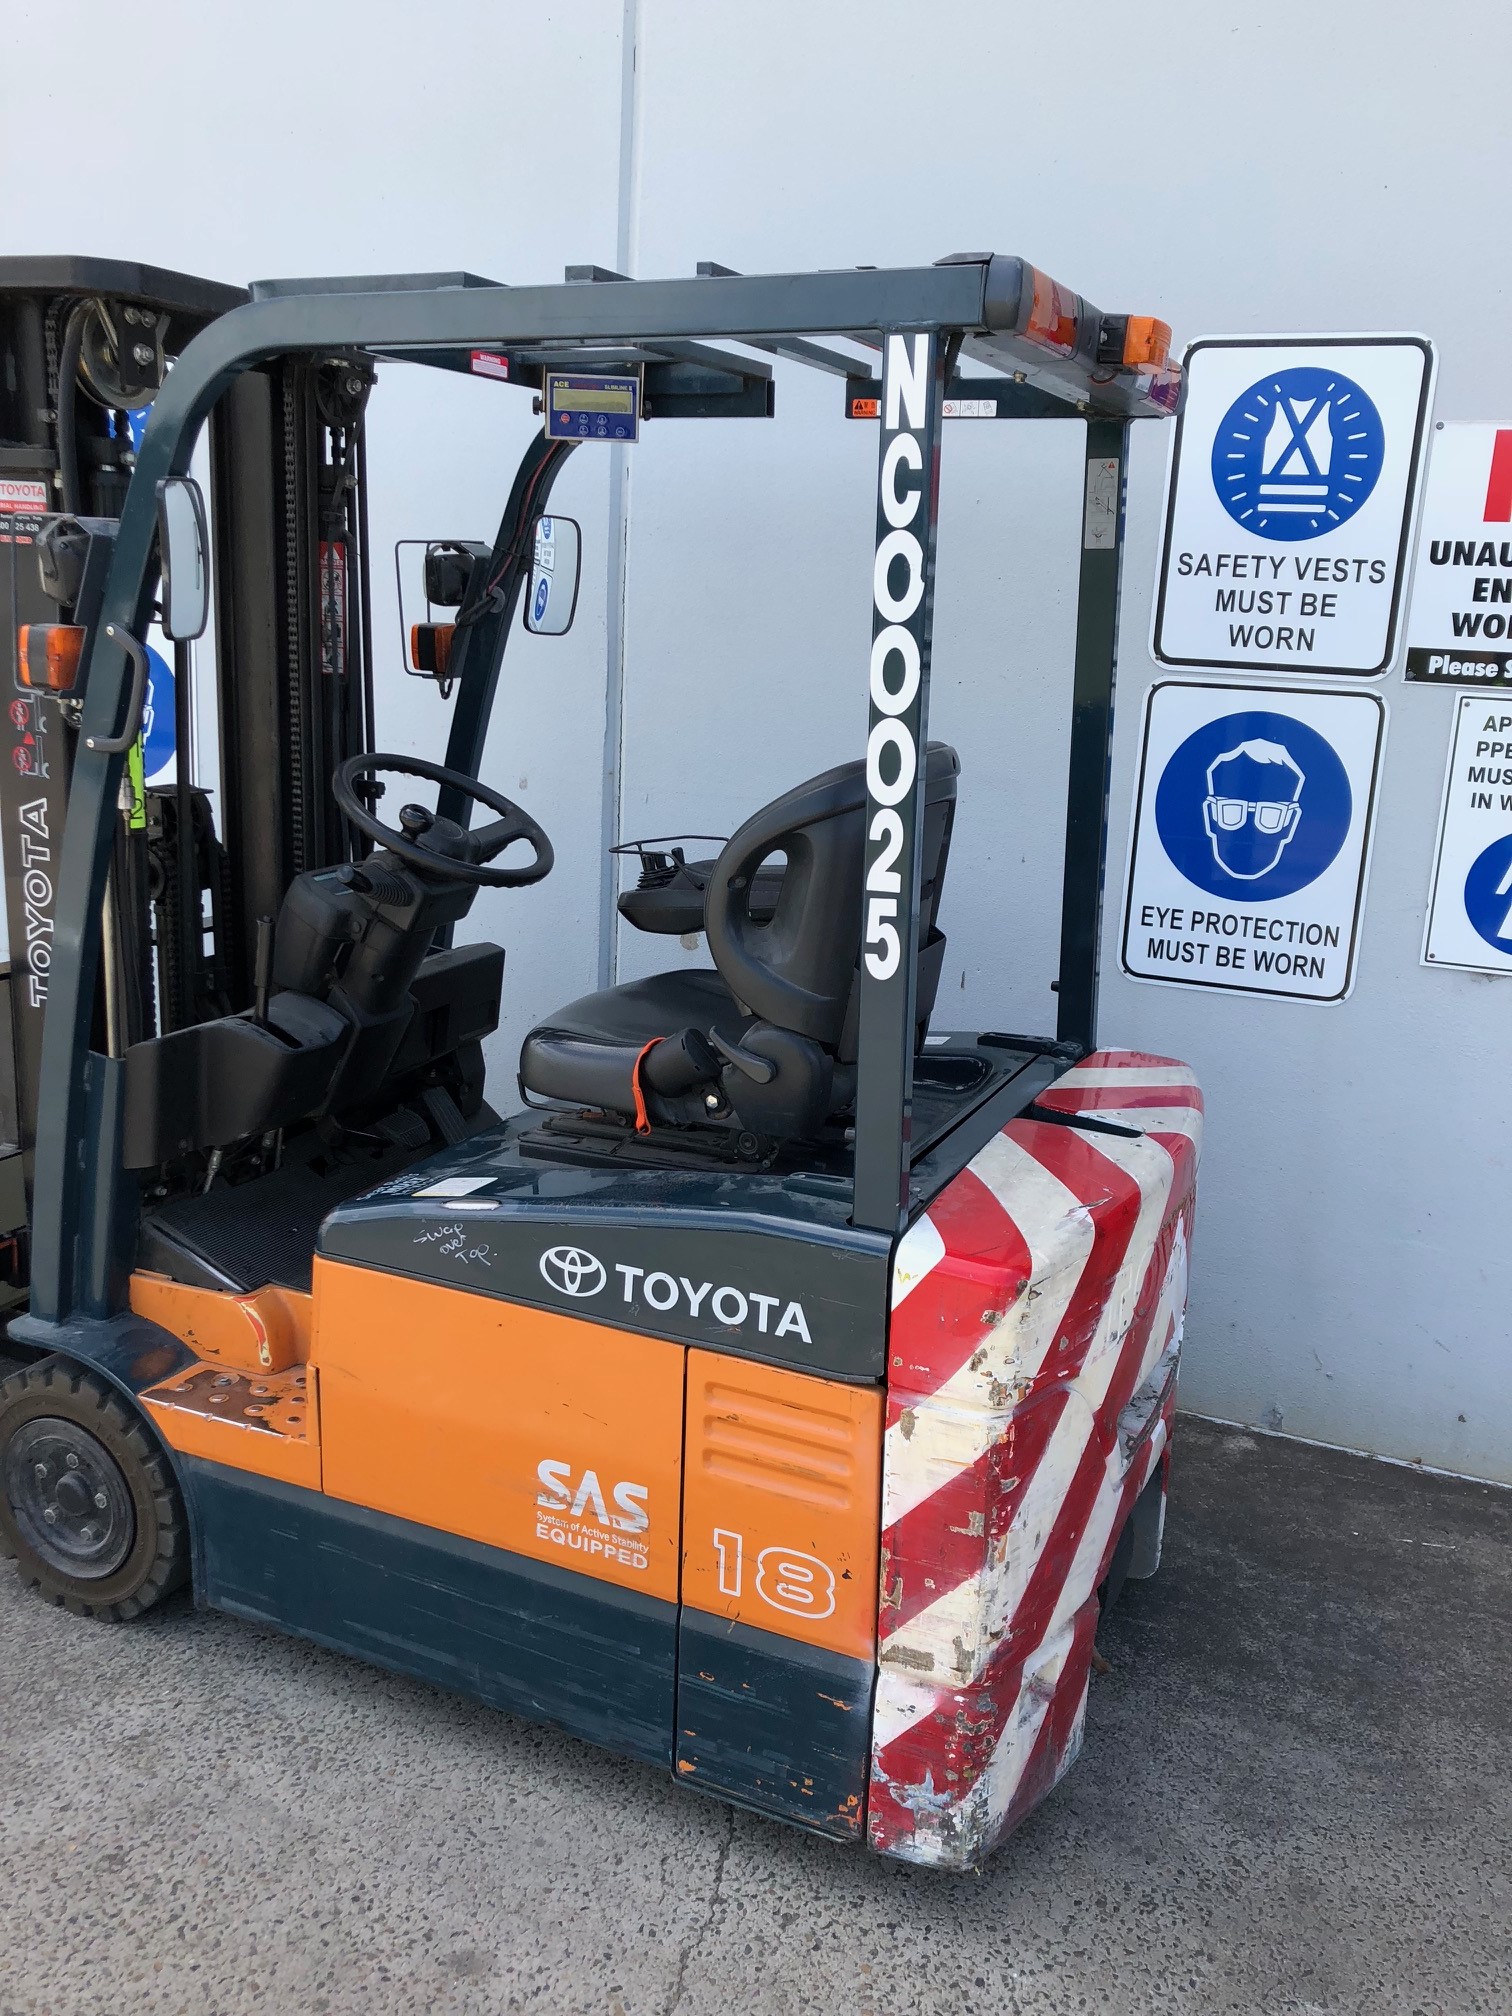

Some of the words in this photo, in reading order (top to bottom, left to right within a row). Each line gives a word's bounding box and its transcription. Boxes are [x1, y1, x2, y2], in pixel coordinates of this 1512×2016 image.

[0, 484, 45, 497] TOYOTA
[25, 523, 40, 532] 438
[1177, 552, 1286, 580] SAFETY
[1294, 556, 1387, 584] VESTS
[1215, 588, 1292, 615] MUST
[1299, 592, 1338, 617] BE
[1229, 624, 1315, 651] WORN
[1451, 612, 1512, 639] WO
[1428, 655, 1499, 678] Please
[1470, 792, 1493, 810] IN
[19, 797, 54, 1008] TOYOTA
[1140, 905, 1184, 931] EYE
[1190, 910, 1340, 948] PROTECTION
[1147, 937, 1209, 965] MUST
[1215, 945, 1247, 970] BE
[1253, 949, 1326, 979] WORN
[615, 1263, 813, 1344] TOYOTA
[537, 1459, 650, 1534] SAS
[536, 1511, 569, 1530] System
[570, 1523, 581, 1532] of
[581, 1525, 610, 1541] Active
[611, 1533, 650, 1554] Stability
[536, 1523, 649, 1569] EQUIPPED
[713, 1527, 836, 1620] 18
